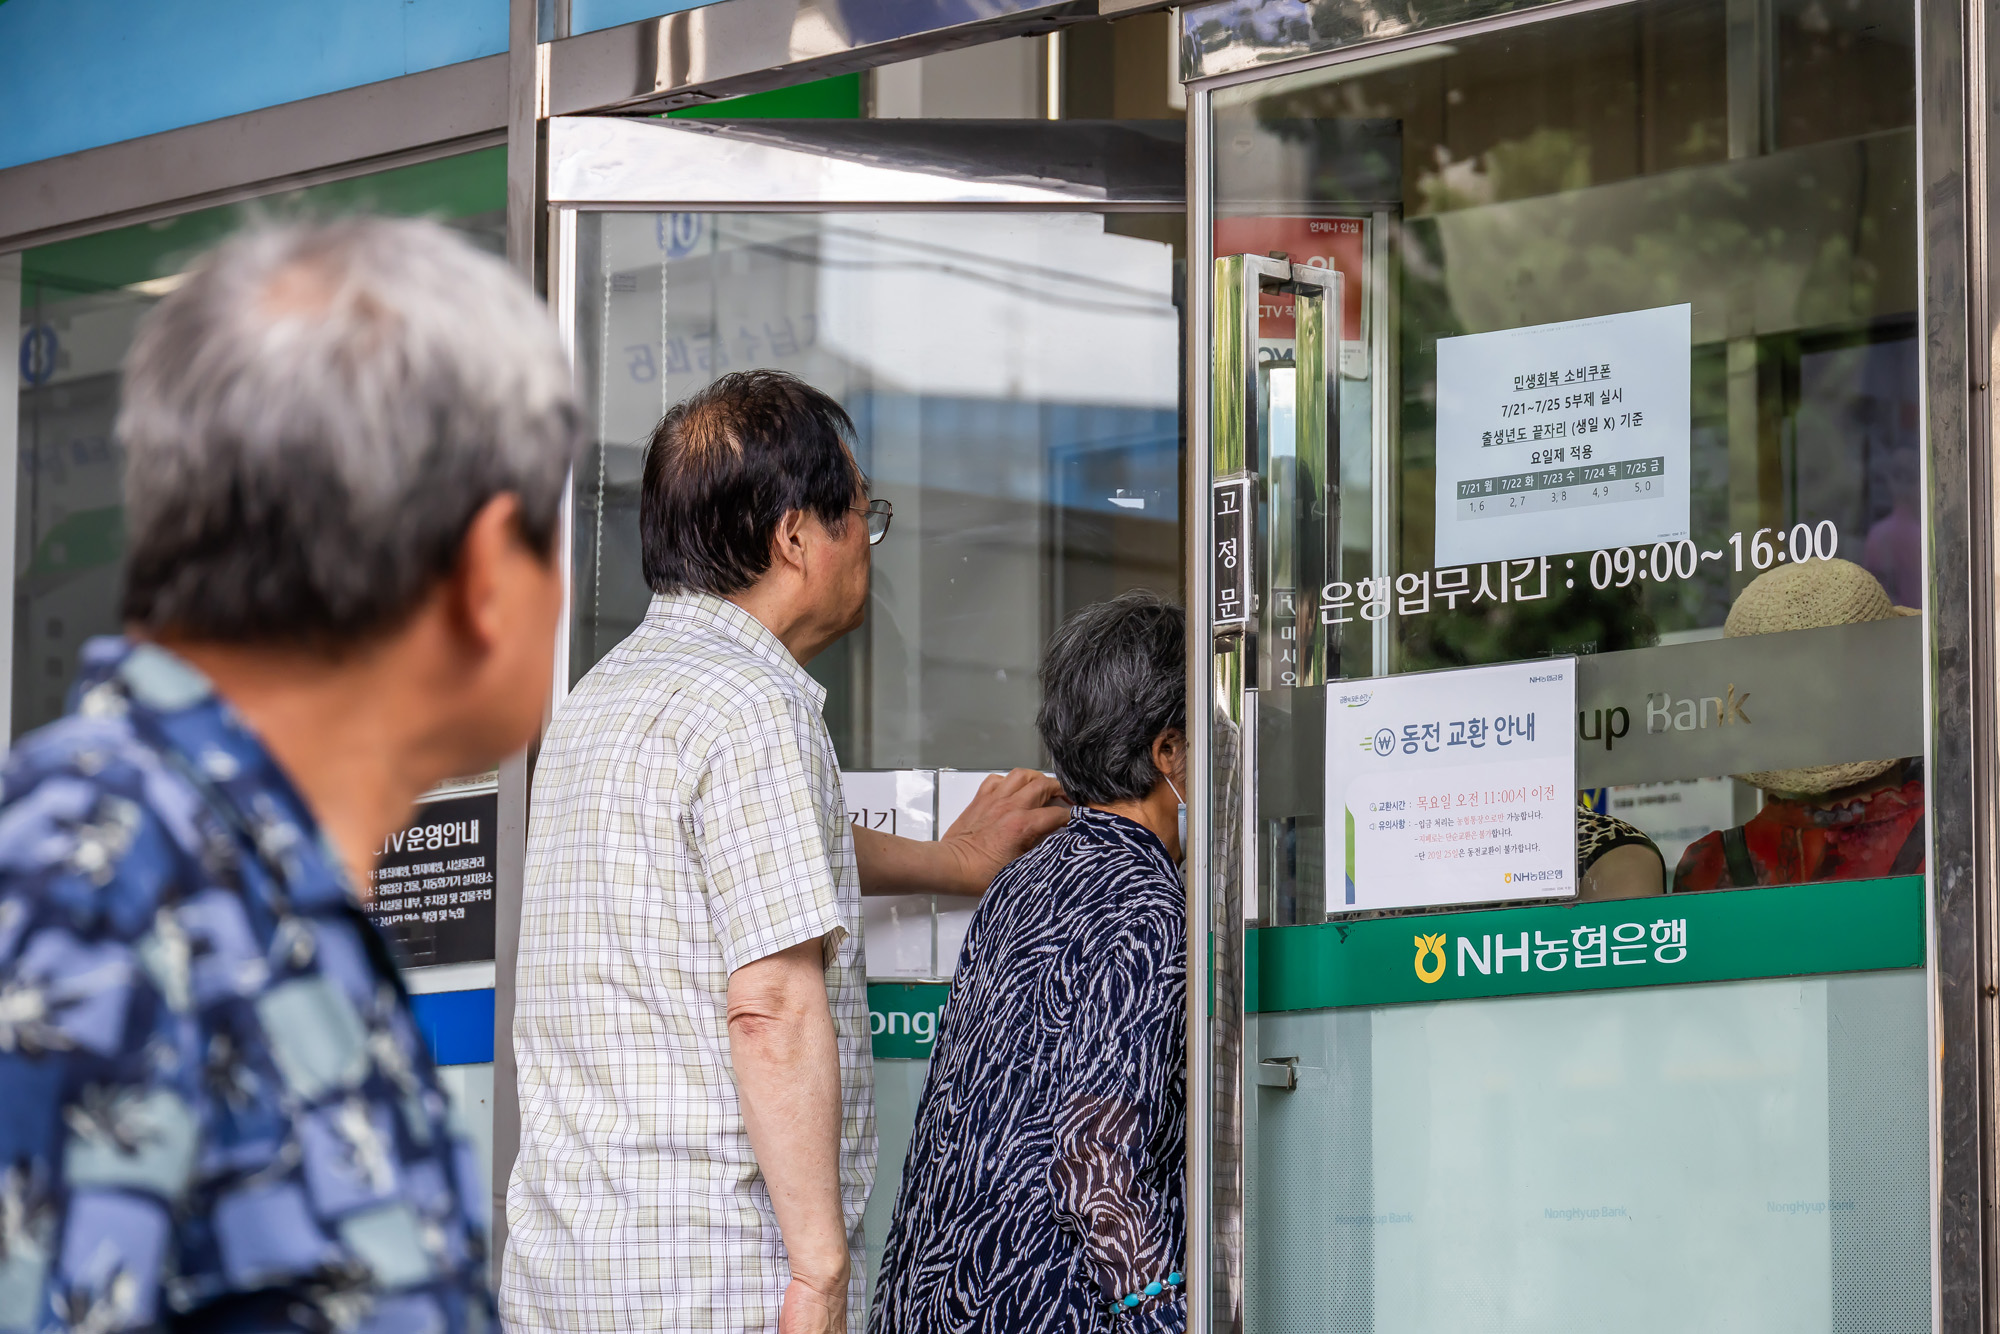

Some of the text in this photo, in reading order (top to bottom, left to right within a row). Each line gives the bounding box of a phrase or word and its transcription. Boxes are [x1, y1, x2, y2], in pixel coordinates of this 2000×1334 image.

[1310, 222, 1359, 234] 언제나 안심
[1514, 364, 1611, 391] 민생회복 소비쿠폰
[1501, 387, 1622, 418] 7/21~7/25 5부제 실시
[1482, 412, 1644, 447] 출생년도 끝자리 (생일 X) 기준
[1531, 444, 1593, 465] 요일제 적용
[1461, 460, 1660, 496] 7/21 월 7/22 화 7/23 수 7/24 목 7/25 금
[1217, 491, 1240, 618] 고정문
[1320, 556, 1551, 625] 은행업무시간
[1590, 520, 1839, 591] 09:00~16:00
[1646, 682, 1752, 734] Bank
[1401, 722, 1440, 754] 동전
[1447, 717, 1488, 748] 교환
[1494, 712, 1535, 746] 안내
[1378, 800, 1406, 812] 교환시간
[1417, 793, 1451, 811] 목요일
[1456, 791, 1478, 807] 오전
[1484, 787, 1526, 805] 11:00시
[1531, 784, 1555, 802] 이전
[1378, 819, 1406, 831] 유의사항
[1435, 817, 1454, 827] 처리는
[1457, 813, 1504, 826] 농협통장으로만
[1507, 809, 1543, 822] 가능합니다.
[1446, 830, 1477, 842] 단순교환은
[1479, 828, 1512, 839] 불가합니다.
[1428, 850, 1442, 860] 20일
[1468, 845, 1501, 857] 동전교환이
[1504, 842, 1541, 853] 불가합니다.
[446, 856, 485, 870] 시설물관리
[379, 882, 402, 896] 영업장
[422, 875, 460, 889] 자동화기기
[462, 872, 493, 886] 설치장소
[1513, 869, 1563, 882] NH농협은행
[379, 899, 402, 911] 시설물
[404, 896, 422, 909] 내부,
[424, 894, 448, 907] 주차장
[449, 892, 458, 904] 및
[460, 889, 492, 903] 건물주변
[439, 909, 448, 921] 및
[1457, 918, 1687, 977] NH농협은행
[1389, 1212, 1414, 1224] Bank
[1544, 1205, 1627, 1220] NongHyup Bank
[1767, 1200, 1826, 1214] NongHyup
